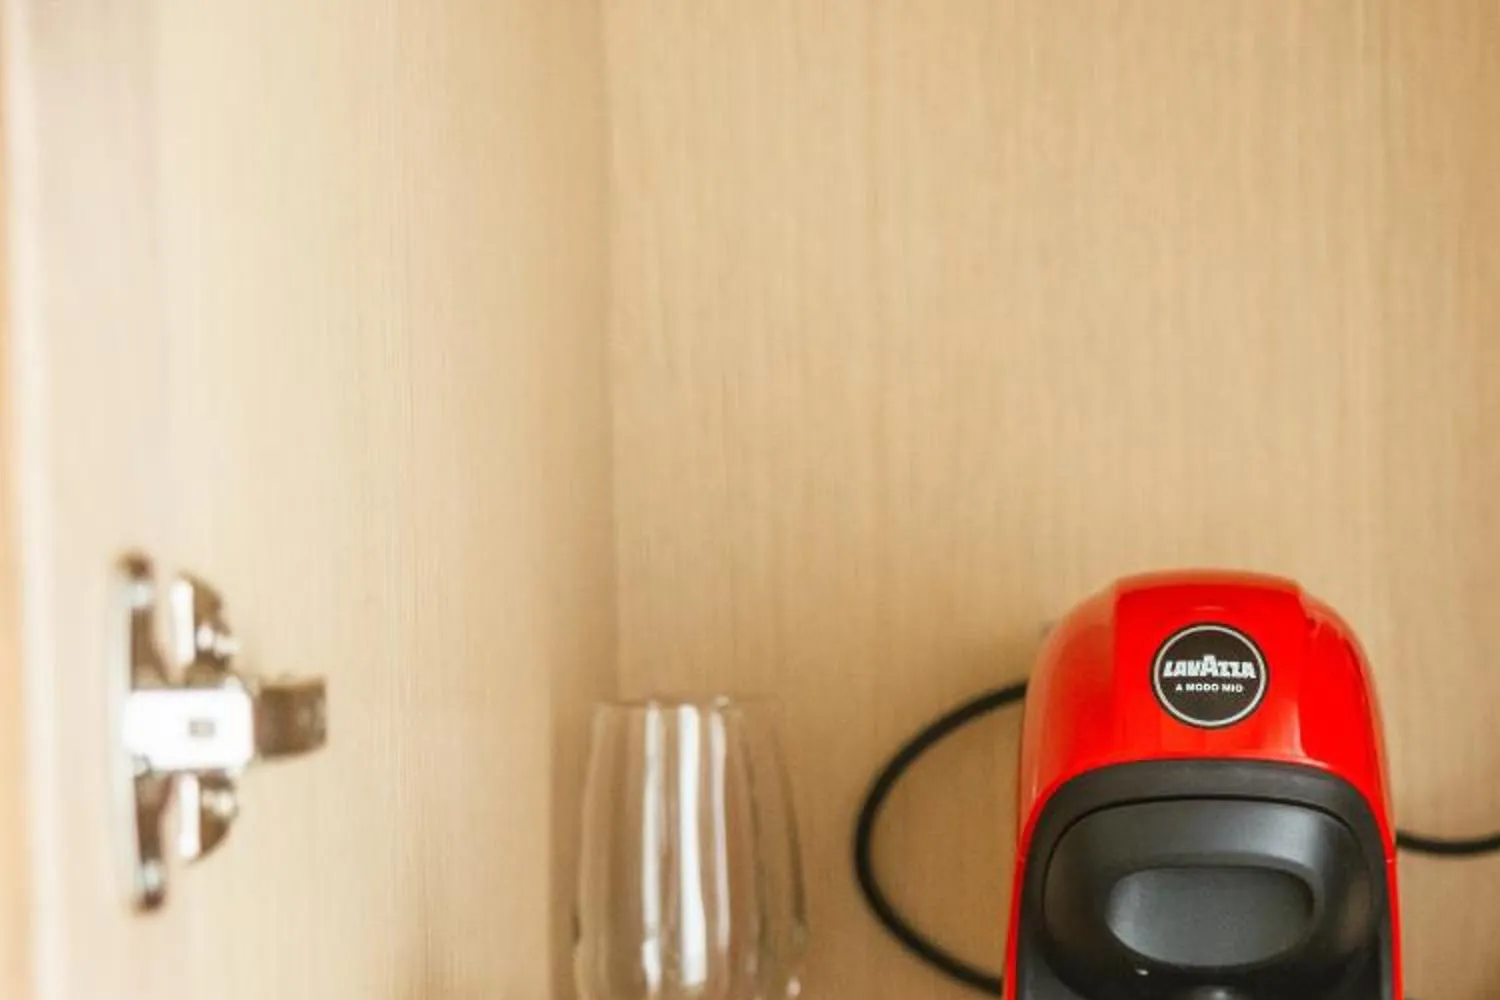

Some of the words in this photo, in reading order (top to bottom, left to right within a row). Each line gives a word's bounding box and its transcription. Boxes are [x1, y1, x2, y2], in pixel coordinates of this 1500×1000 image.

[1163, 655, 1256, 678] LAVAZZA
[1186, 684, 1219, 692] MODO
[1222, 684, 1244, 693] MIO
